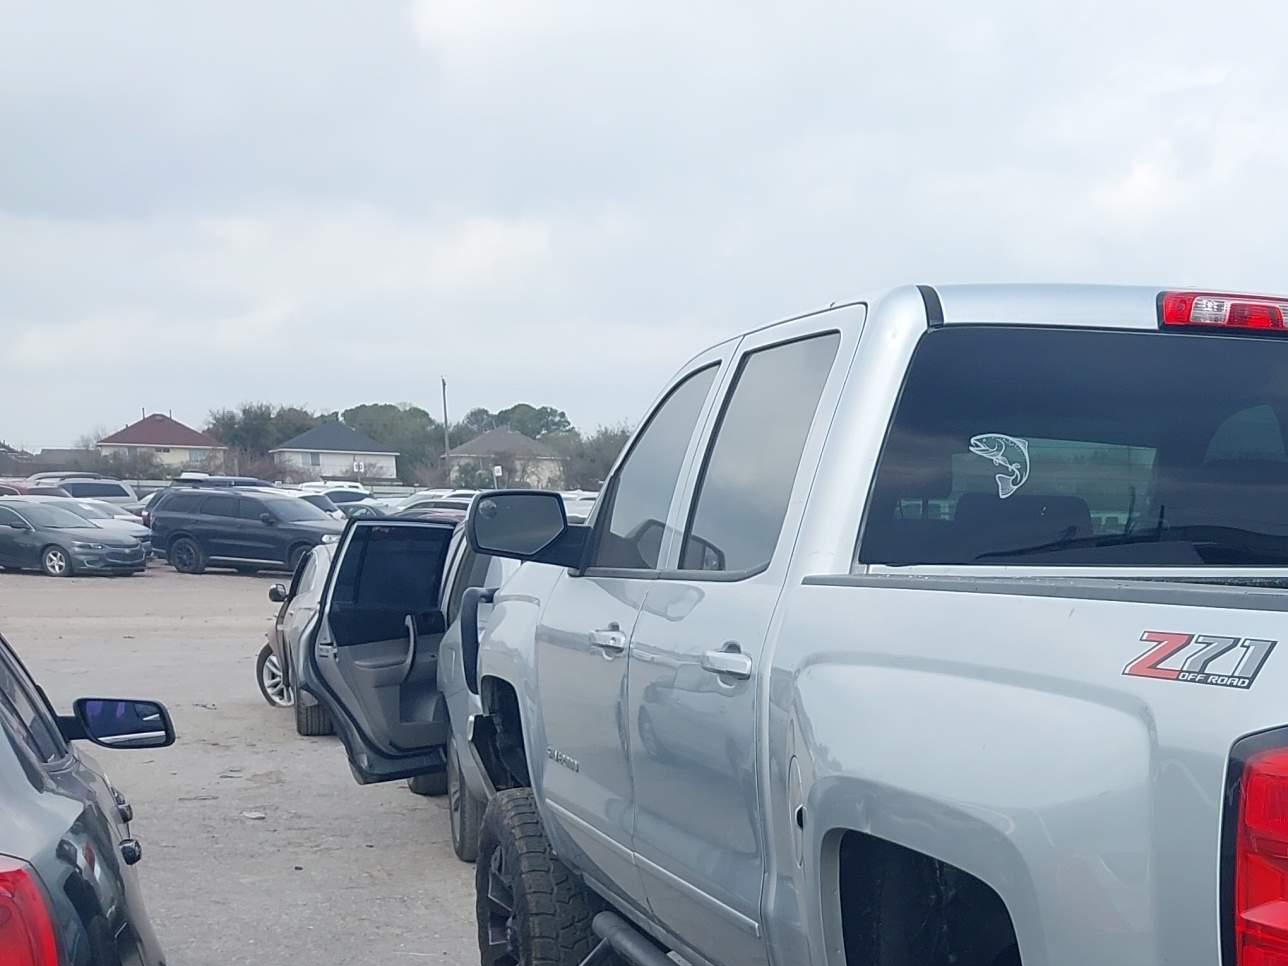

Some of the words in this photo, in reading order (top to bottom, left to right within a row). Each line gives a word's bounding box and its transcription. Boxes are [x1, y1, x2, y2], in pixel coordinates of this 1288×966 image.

[1121, 630, 1278, 682] Z71
[1178, 671, 1207, 682] OFF
[1207, 675, 1250, 688] ROAD
